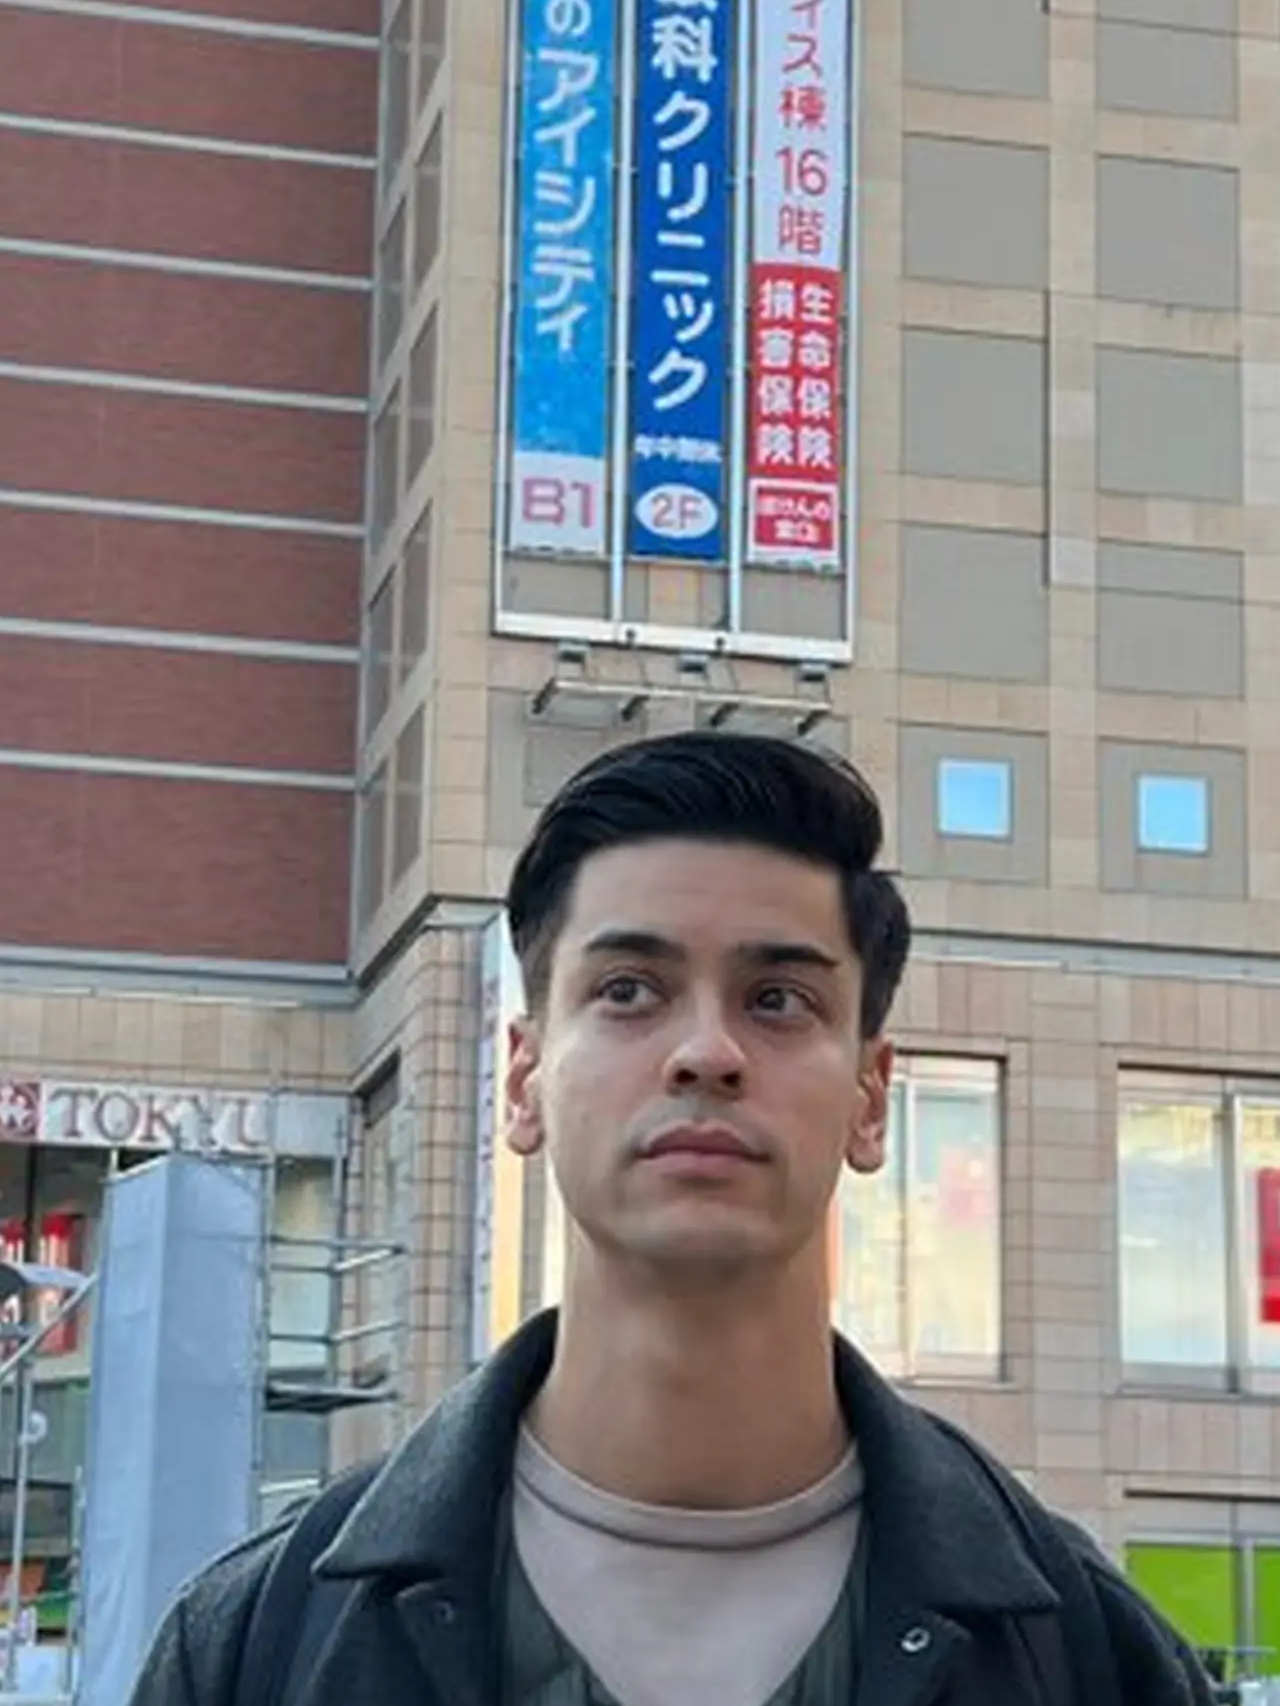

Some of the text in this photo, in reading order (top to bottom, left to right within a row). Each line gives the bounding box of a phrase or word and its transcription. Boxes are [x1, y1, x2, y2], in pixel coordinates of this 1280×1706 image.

[797, 282, 834, 470] 生命保険
[522, 477, 598, 529] B1
[651, 493, 703, 529] 2F
[49, 1087, 271, 1148] TOKYU
